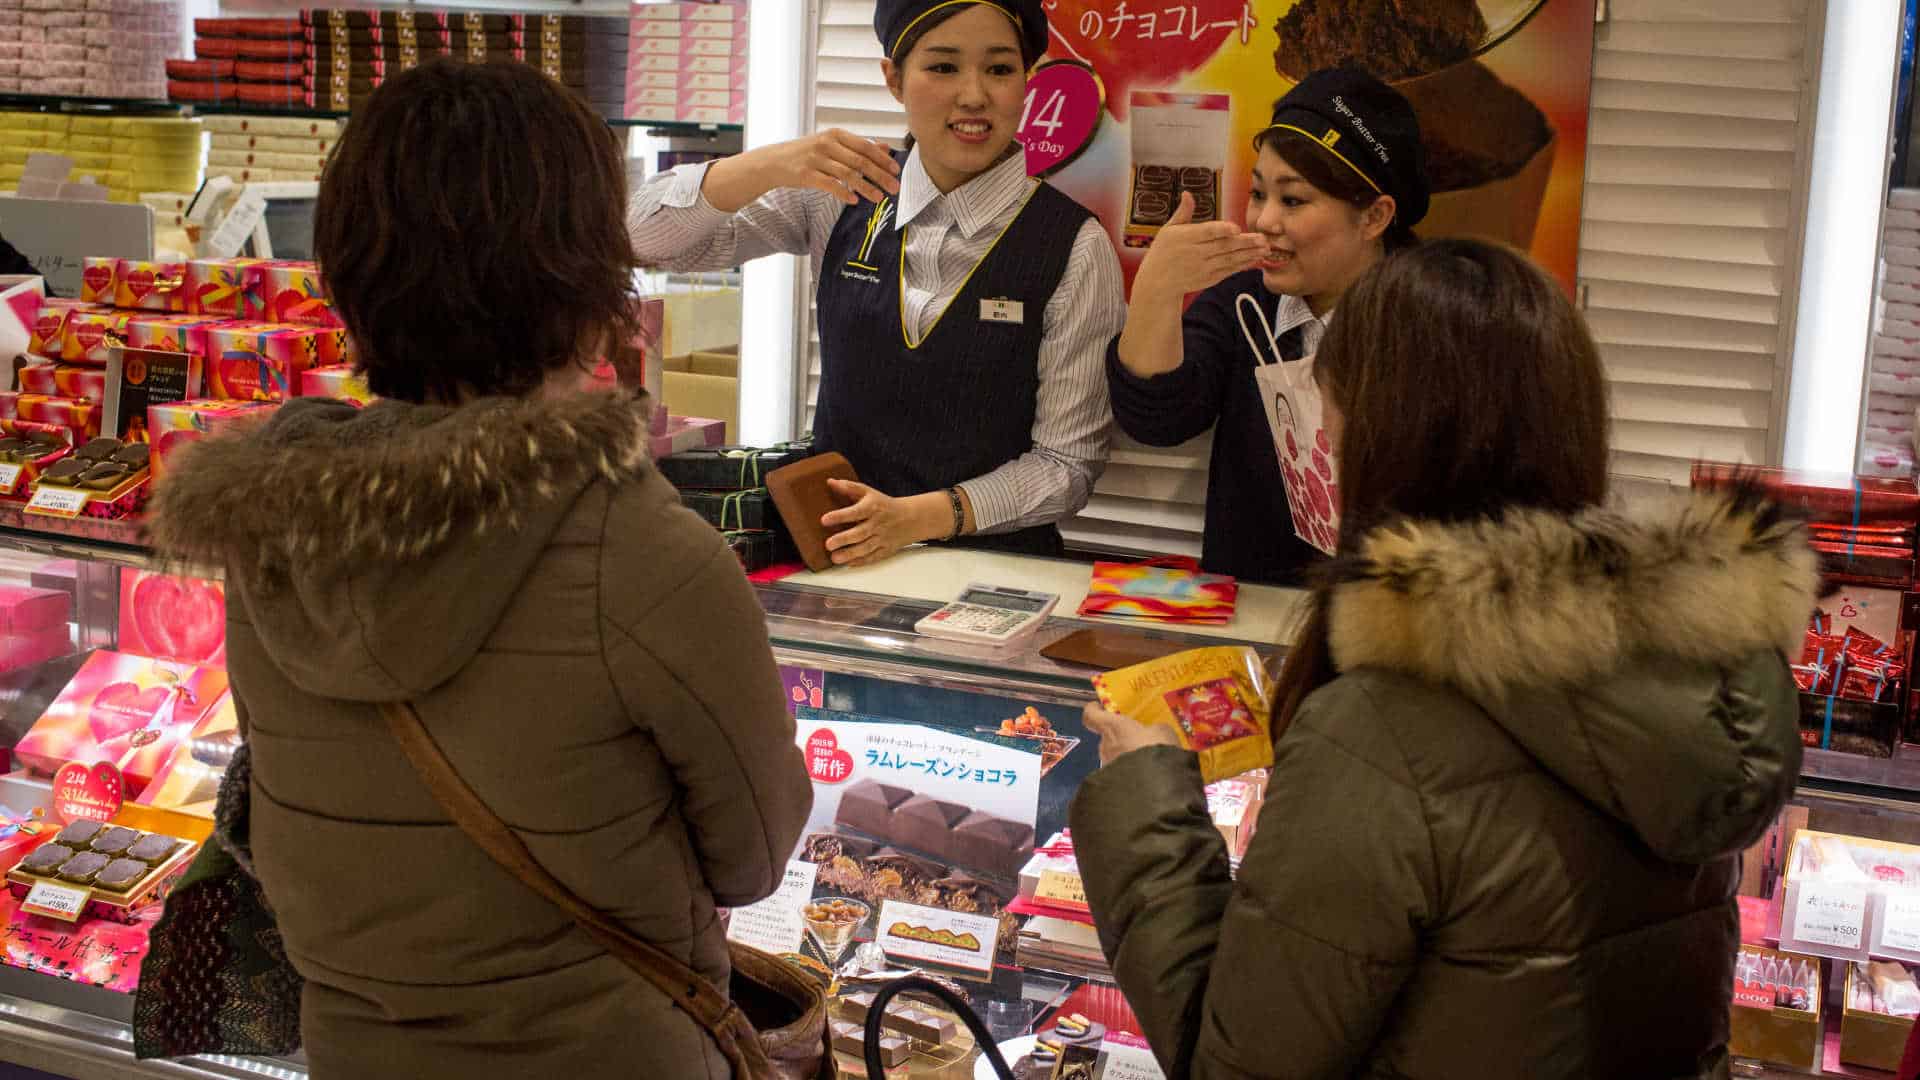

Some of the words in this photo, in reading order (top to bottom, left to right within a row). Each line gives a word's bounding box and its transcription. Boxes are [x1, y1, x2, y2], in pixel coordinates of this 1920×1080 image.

[1080, 1, 1257, 44] のチョコレート
[1016, 88, 1066, 137] 14
[1038, 141, 1065, 157] Day
[812, 757, 846, 778] 新作
[865, 749, 1018, 786] ラムレーズンショコラ
